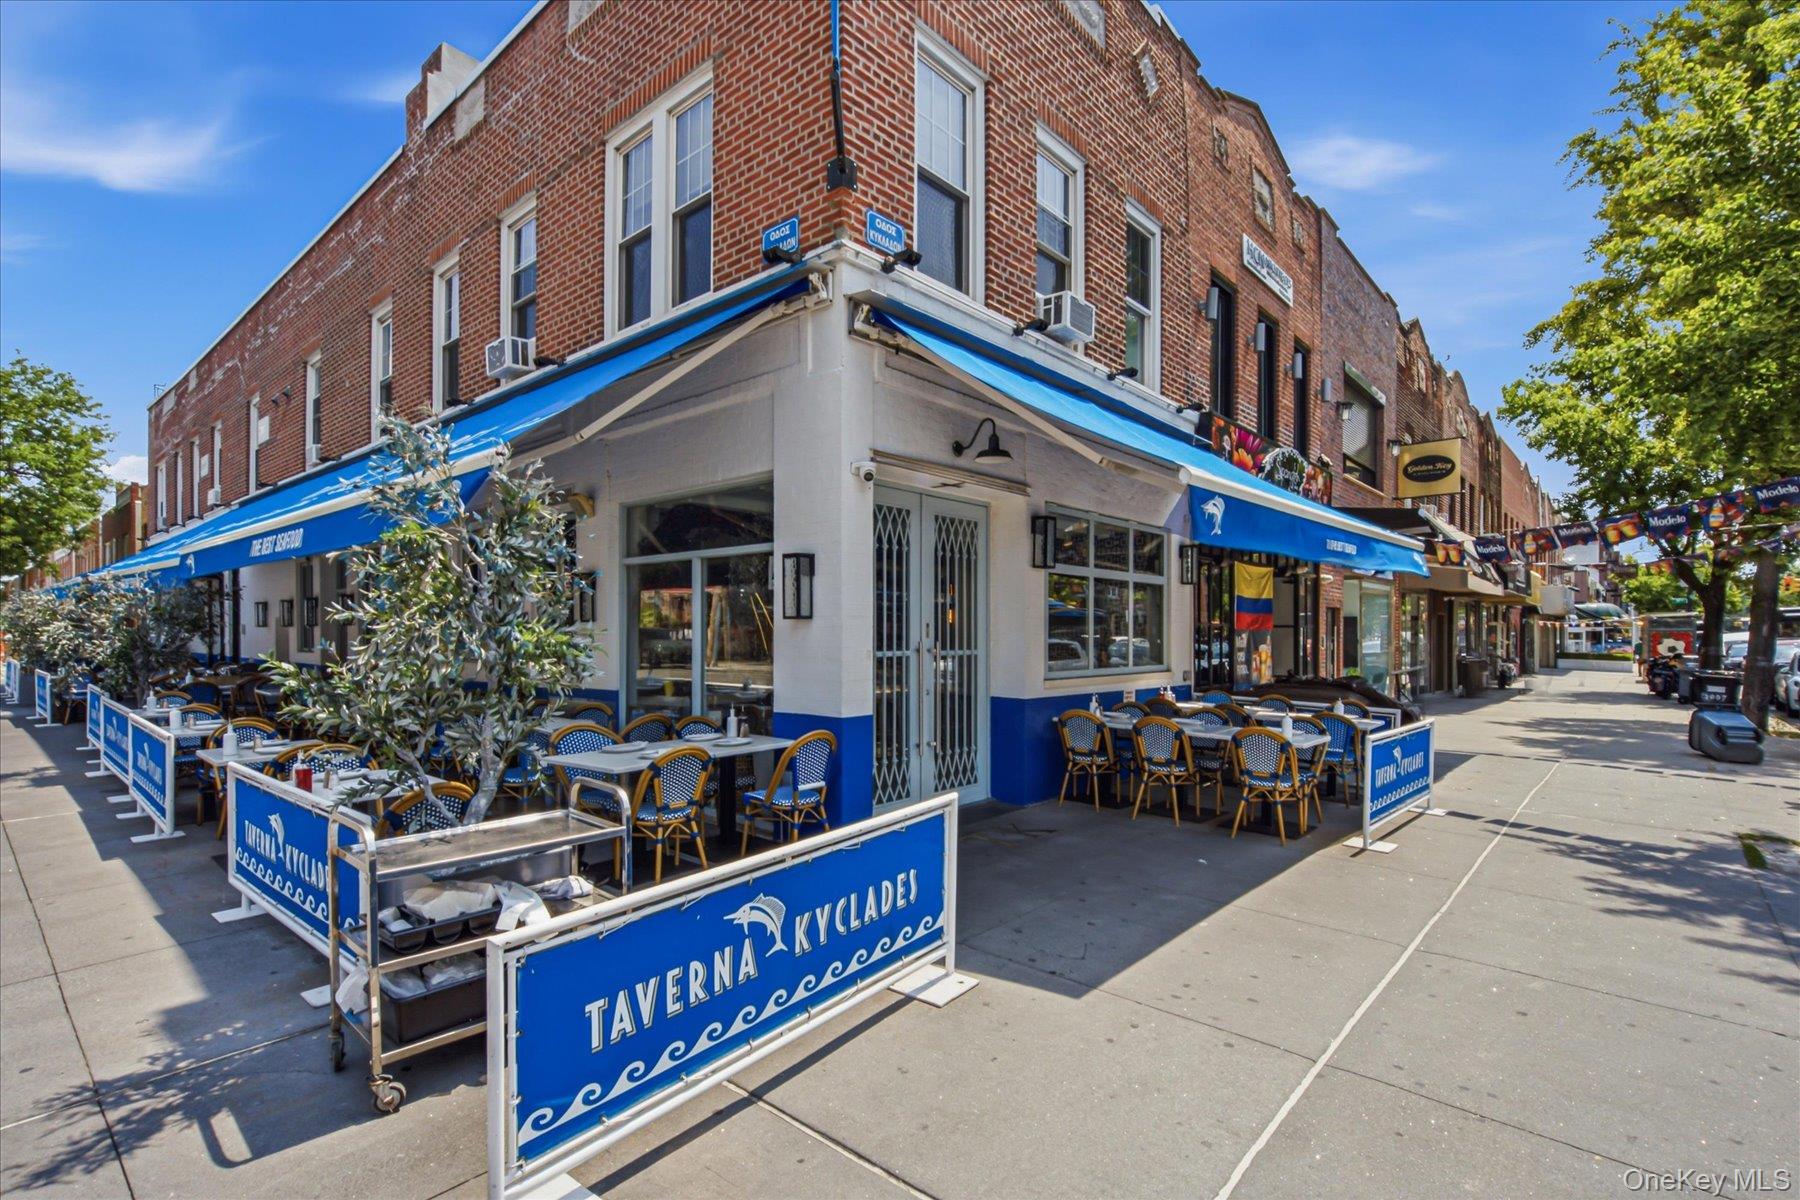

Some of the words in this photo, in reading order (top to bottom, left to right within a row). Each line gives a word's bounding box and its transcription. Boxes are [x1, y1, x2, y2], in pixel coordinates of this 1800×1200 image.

[1756, 483, 1800, 501] Modelo
[1648, 514, 1687, 528] Modelo
[1476, 544, 1506, 554] Modelo
[244, 820, 277, 864] TAVERNA
[584, 937, 759, 1054] TAVERNA
[794, 868, 918, 957] KYCLADES
